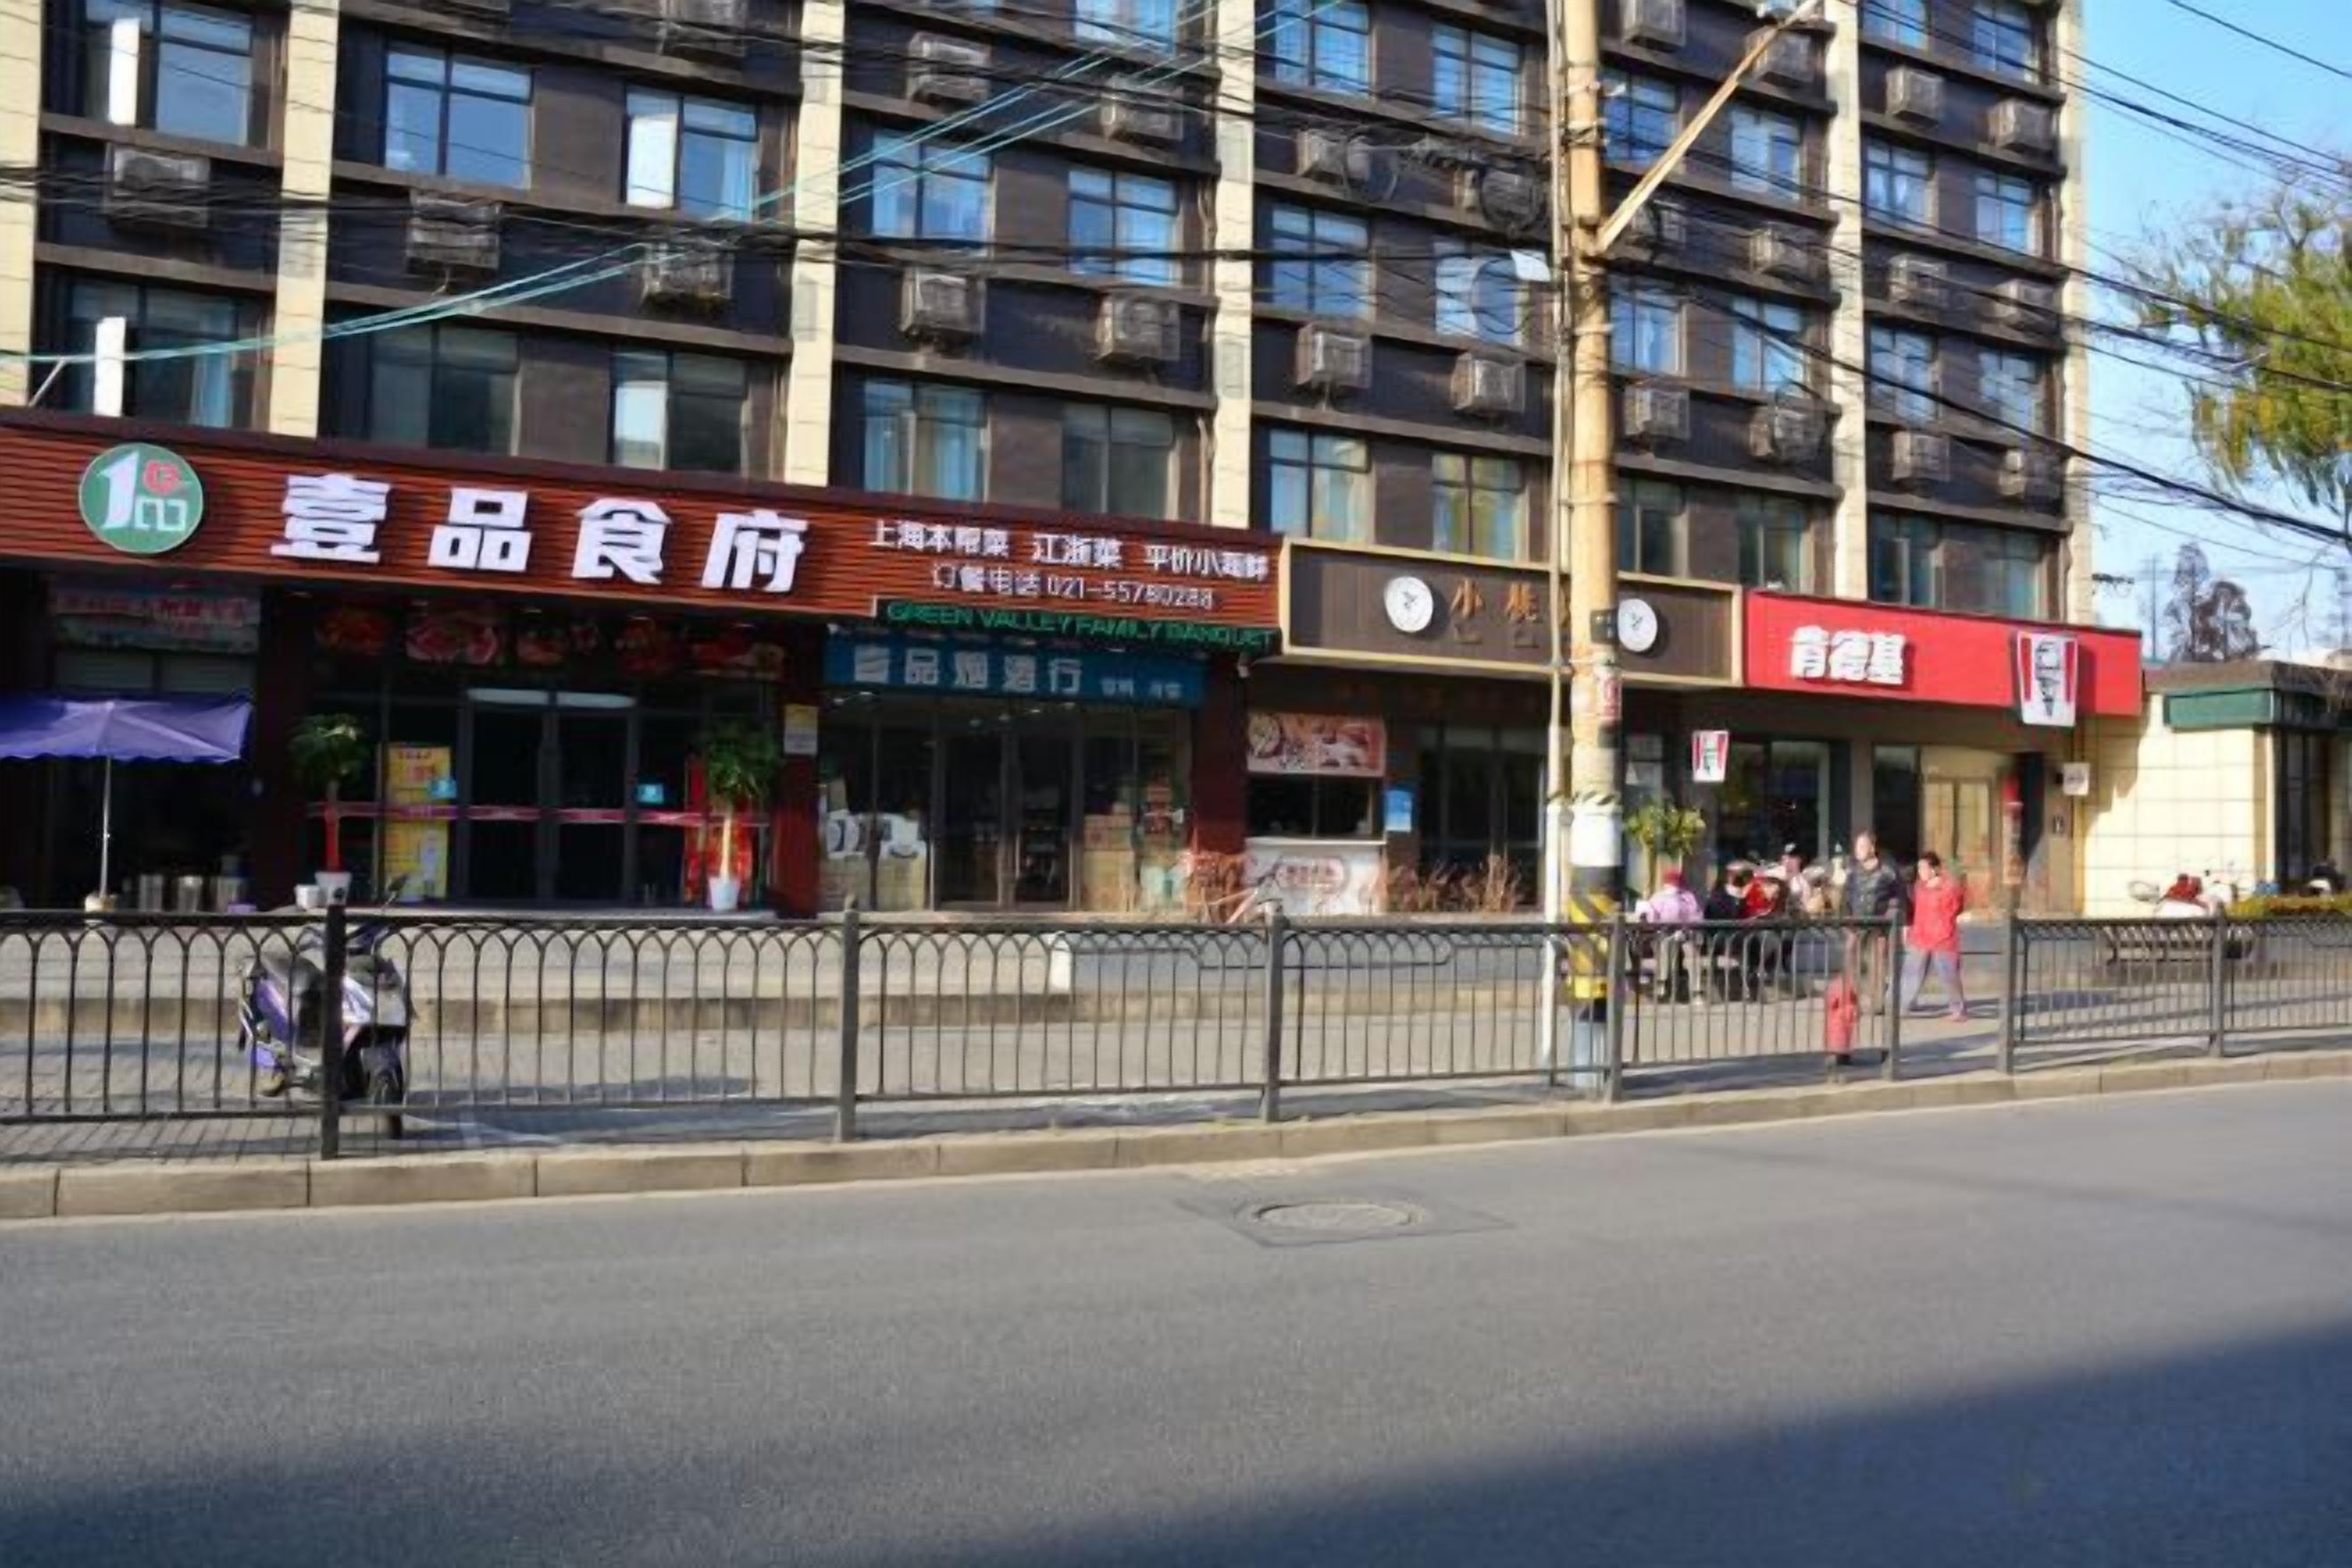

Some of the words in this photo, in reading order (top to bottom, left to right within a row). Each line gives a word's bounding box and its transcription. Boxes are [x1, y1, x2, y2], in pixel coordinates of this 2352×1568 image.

[270, 473, 808, 592] 壹品食府
[886, 601, 974, 625] GREEN
